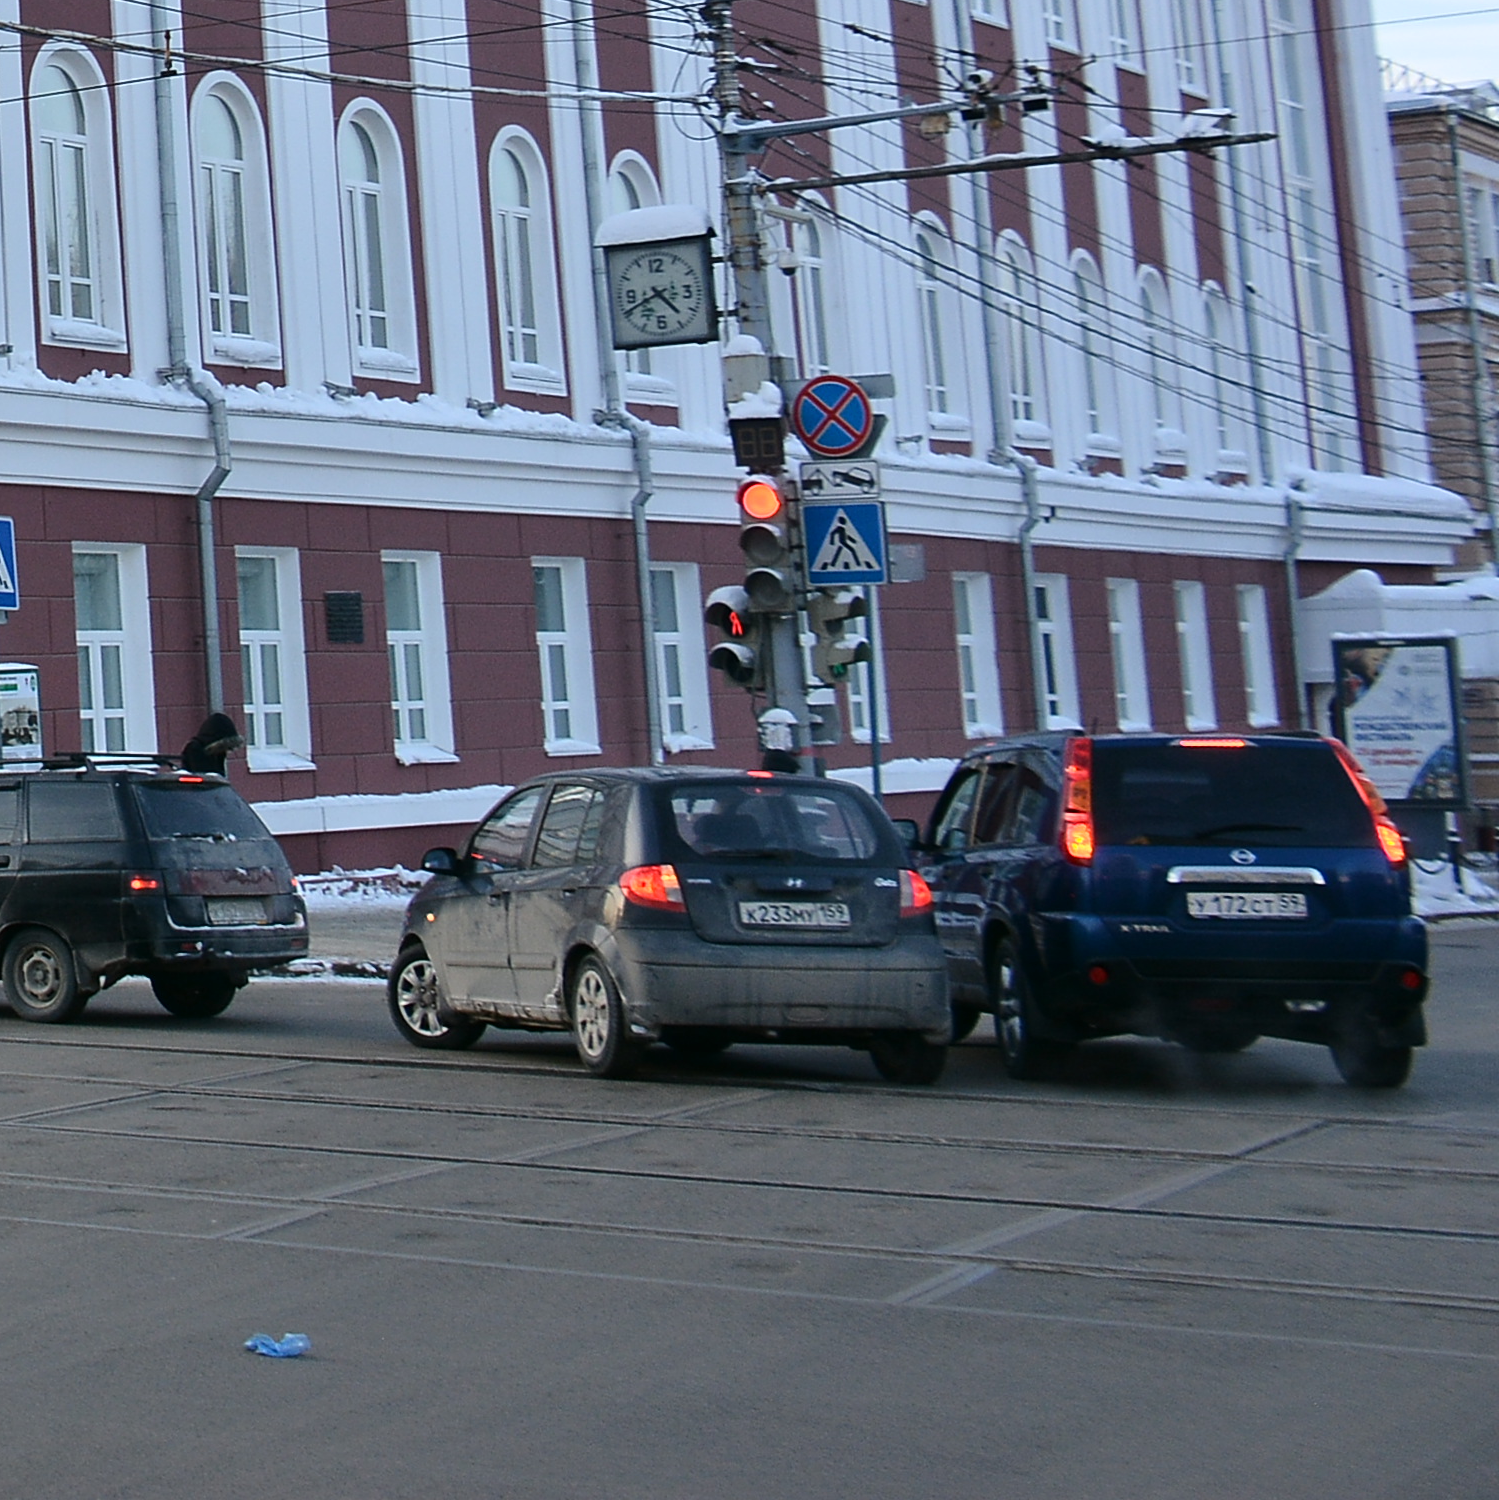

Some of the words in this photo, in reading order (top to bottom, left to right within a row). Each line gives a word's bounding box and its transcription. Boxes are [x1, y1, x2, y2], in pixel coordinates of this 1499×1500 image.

[648, 258, 664, 273] 12
[626, 289, 636, 304] 9
[682, 285, 692, 299] 3
[656, 315, 667, 330] 6
